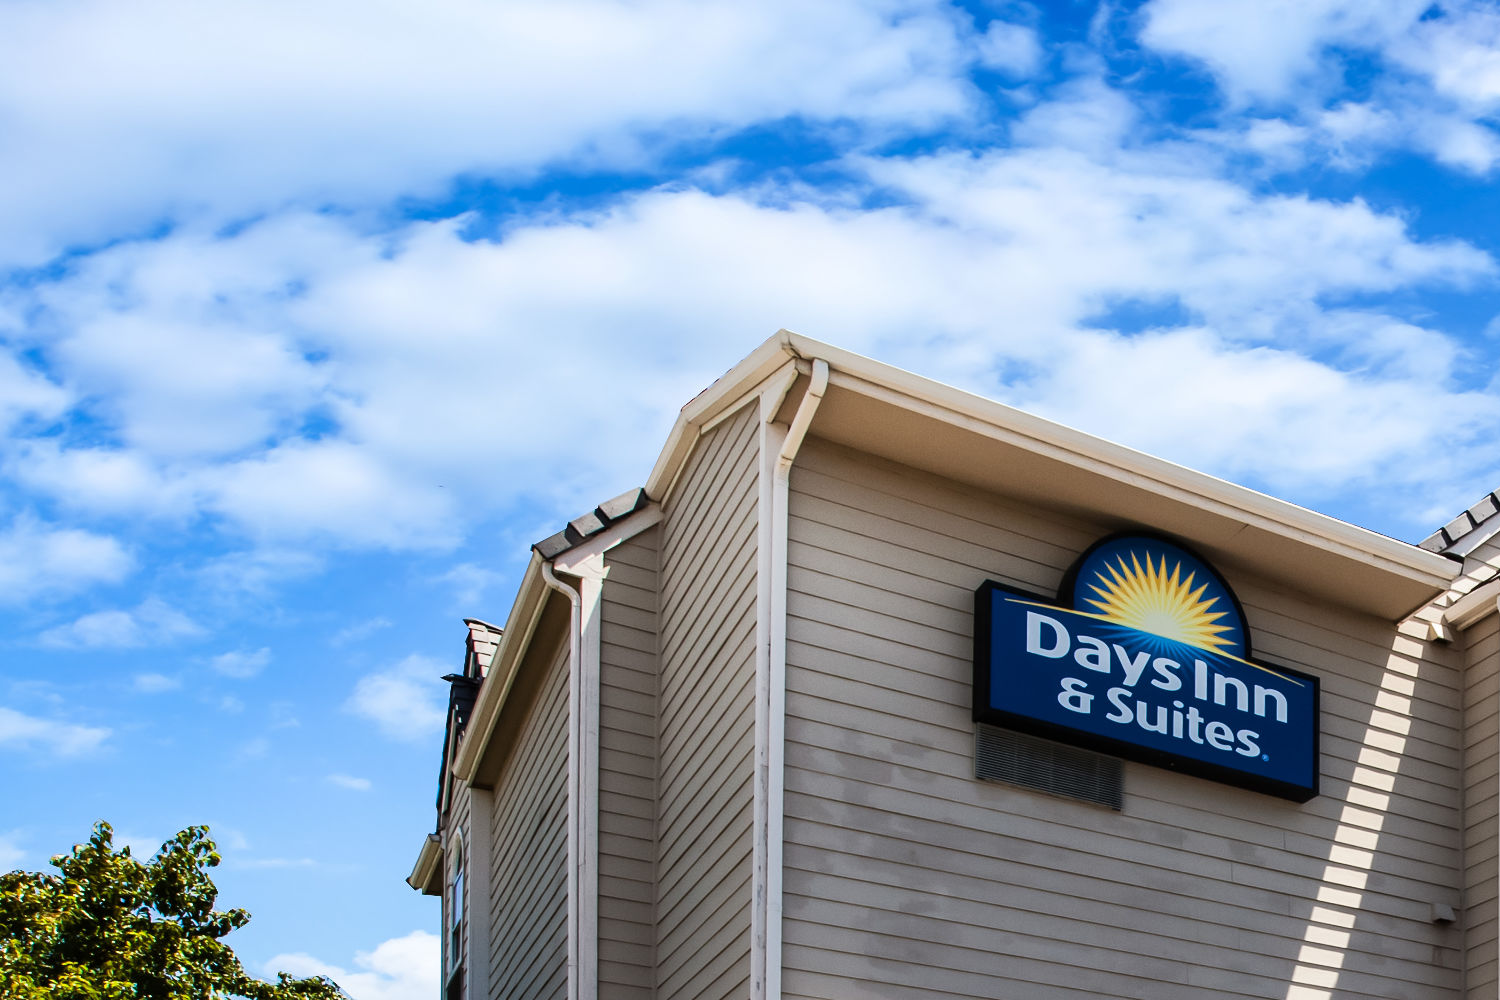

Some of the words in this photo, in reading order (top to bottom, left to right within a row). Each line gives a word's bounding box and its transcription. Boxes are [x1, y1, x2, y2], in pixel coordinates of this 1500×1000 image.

[1026, 611, 1181, 691] Days
[1194, 659, 1288, 723] Inn
[1057, 677, 1095, 714] &
[1106, 687, 1260, 758] Suites
